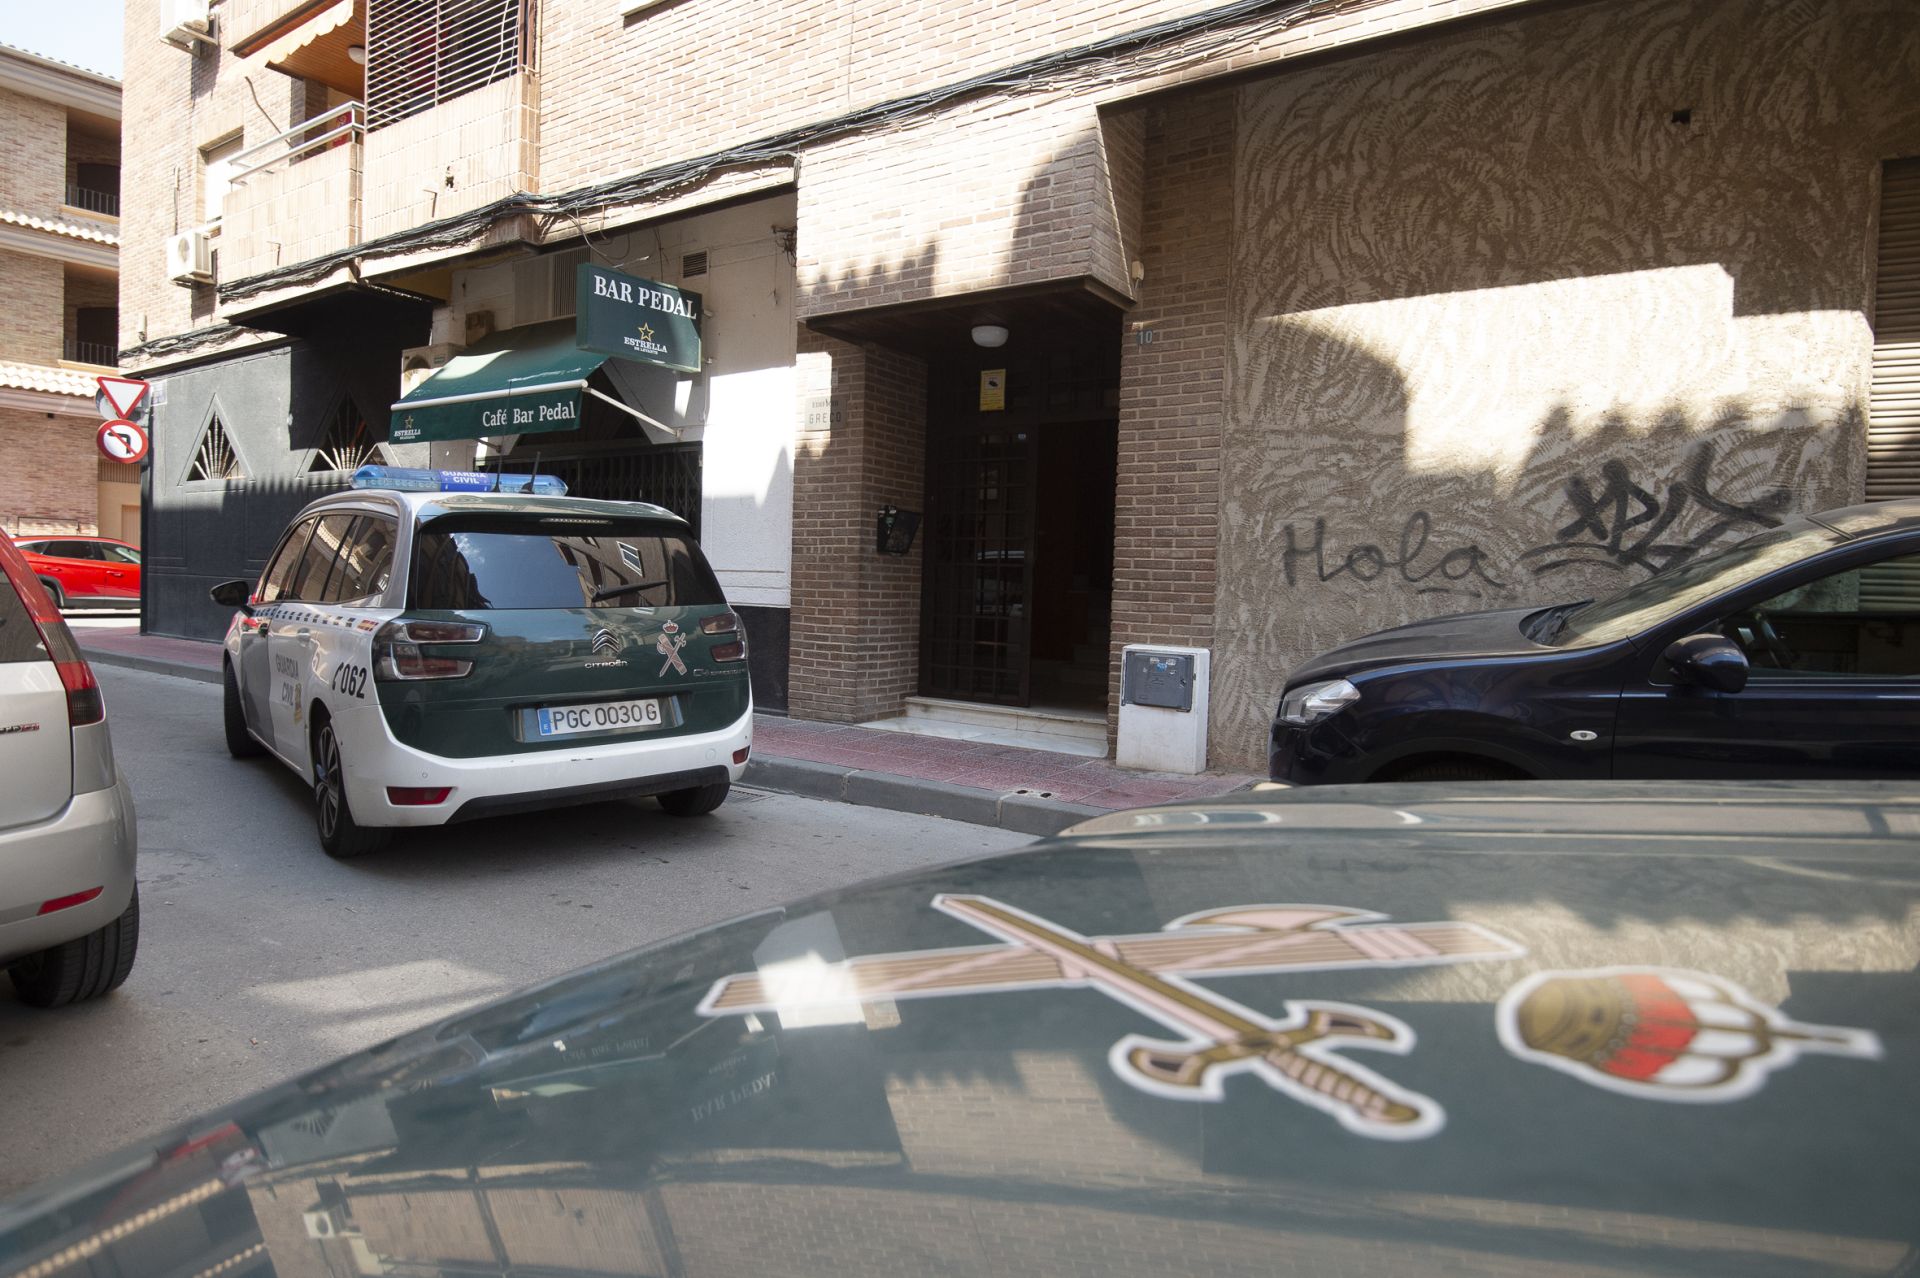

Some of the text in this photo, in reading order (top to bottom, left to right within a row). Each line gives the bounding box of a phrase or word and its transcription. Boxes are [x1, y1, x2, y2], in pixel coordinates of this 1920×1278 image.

[593, 275, 697, 320] BAR PEDAL
[623, 336, 668, 353] ESTRELLA
[1139, 330, 1153, 345] 10
[482, 401, 576, 427] Café Bar Pedal
[809, 411, 842, 424] GRECO
[394, 429, 421, 437] ESTRELLA
[442, 470, 487, 478] GUARDIA
[453, 476, 480, 484] CIVIL
[1283, 510, 1507, 589] Hola
[340, 663, 367, 699] 062
[552, 709, 591, 730] PGC
[646, 703, 657, 721] G
